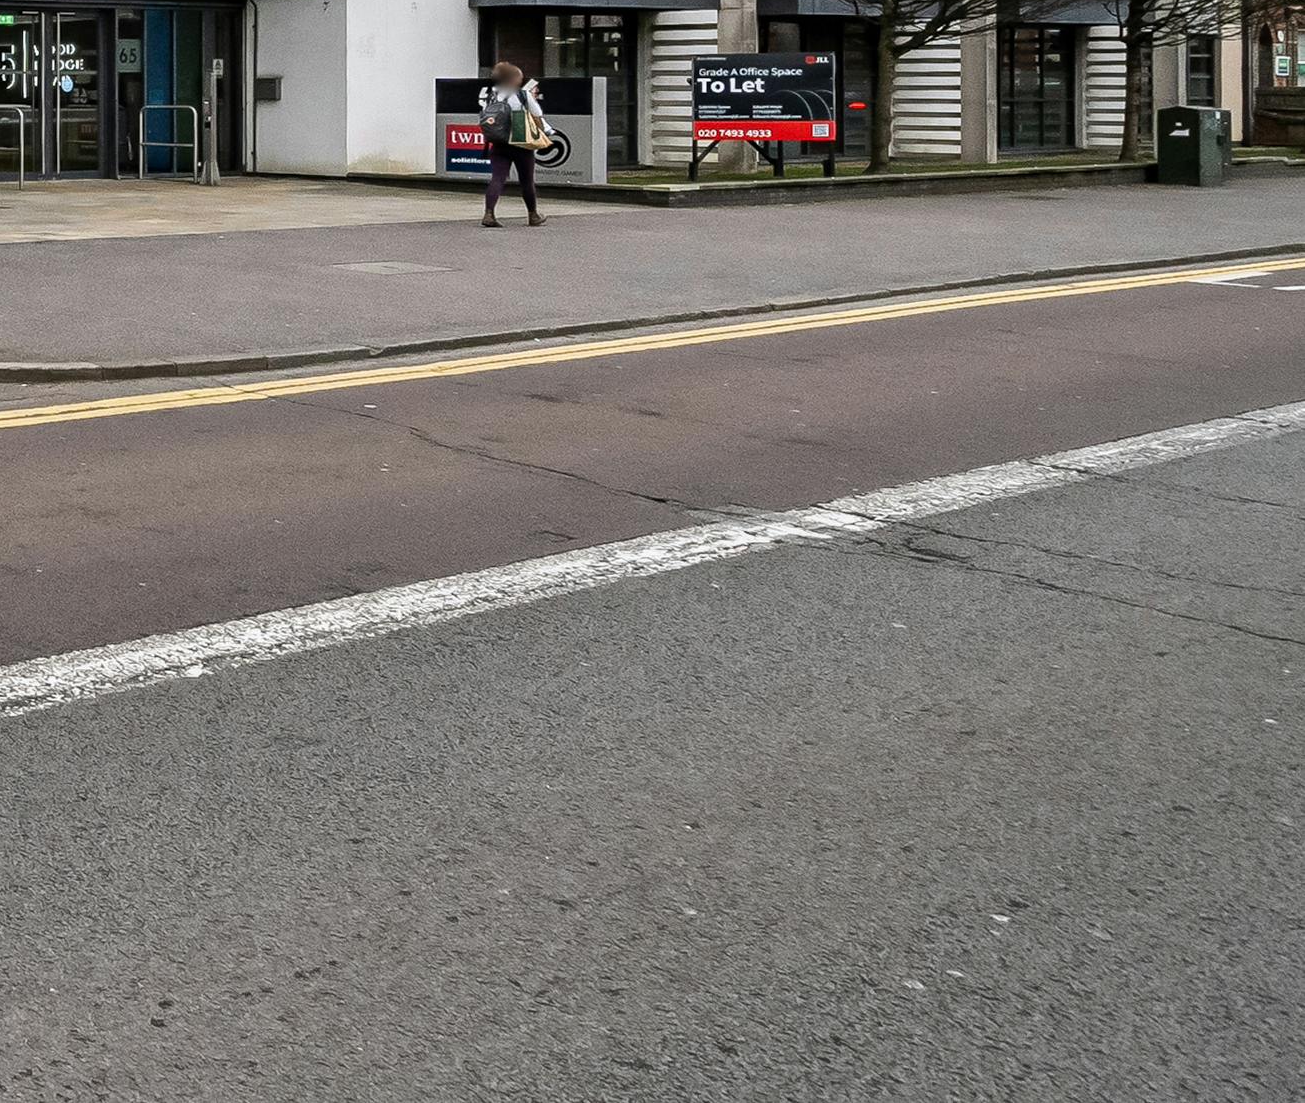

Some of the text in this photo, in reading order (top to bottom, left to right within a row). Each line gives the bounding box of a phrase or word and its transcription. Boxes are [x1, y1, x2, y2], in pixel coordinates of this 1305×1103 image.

[119, 48, 137, 64] 65
[699, 67, 803, 77] Grade A Office Space
[697, 78, 765, 93] To Let
[698, 129, 772, 138] 020 7493 4933
[451, 157, 491, 165] solicitors
